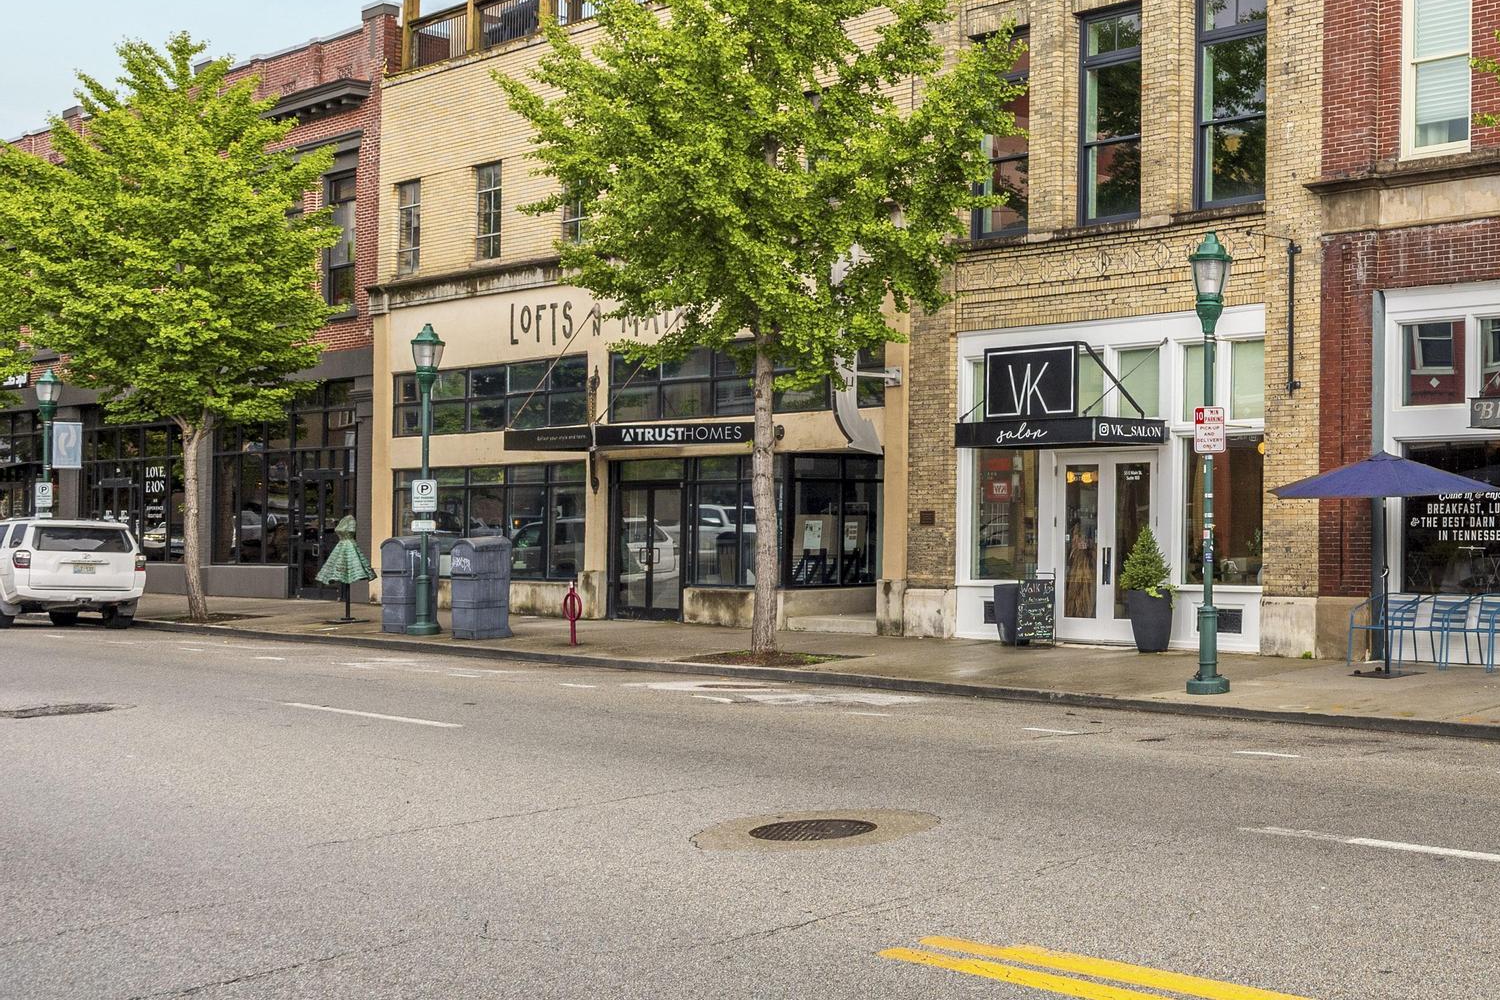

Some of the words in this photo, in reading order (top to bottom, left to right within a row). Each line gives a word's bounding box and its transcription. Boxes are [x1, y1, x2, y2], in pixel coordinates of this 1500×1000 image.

[510, 300, 574, 346] LOFTS
[1008, 361, 1049, 416] VK
[1196, 411, 1204, 421] 10
[637, 426, 742, 442] TRUSTHOMES
[996, 422, 1048, 443] salon
[1110, 424, 1161, 438] VK_SALON
[145, 466, 166, 478] LOVE,
[145, 480, 165, 493] EROS
[421, 484, 429, 494] P
[1427, 503, 1485, 515] BREAKFAST,
[1421, 516, 1438, 528] THE
[1442, 516, 1466, 528] BEST
[1469, 516, 1495, 528] DARN
[1438, 530, 1448, 541] IN
